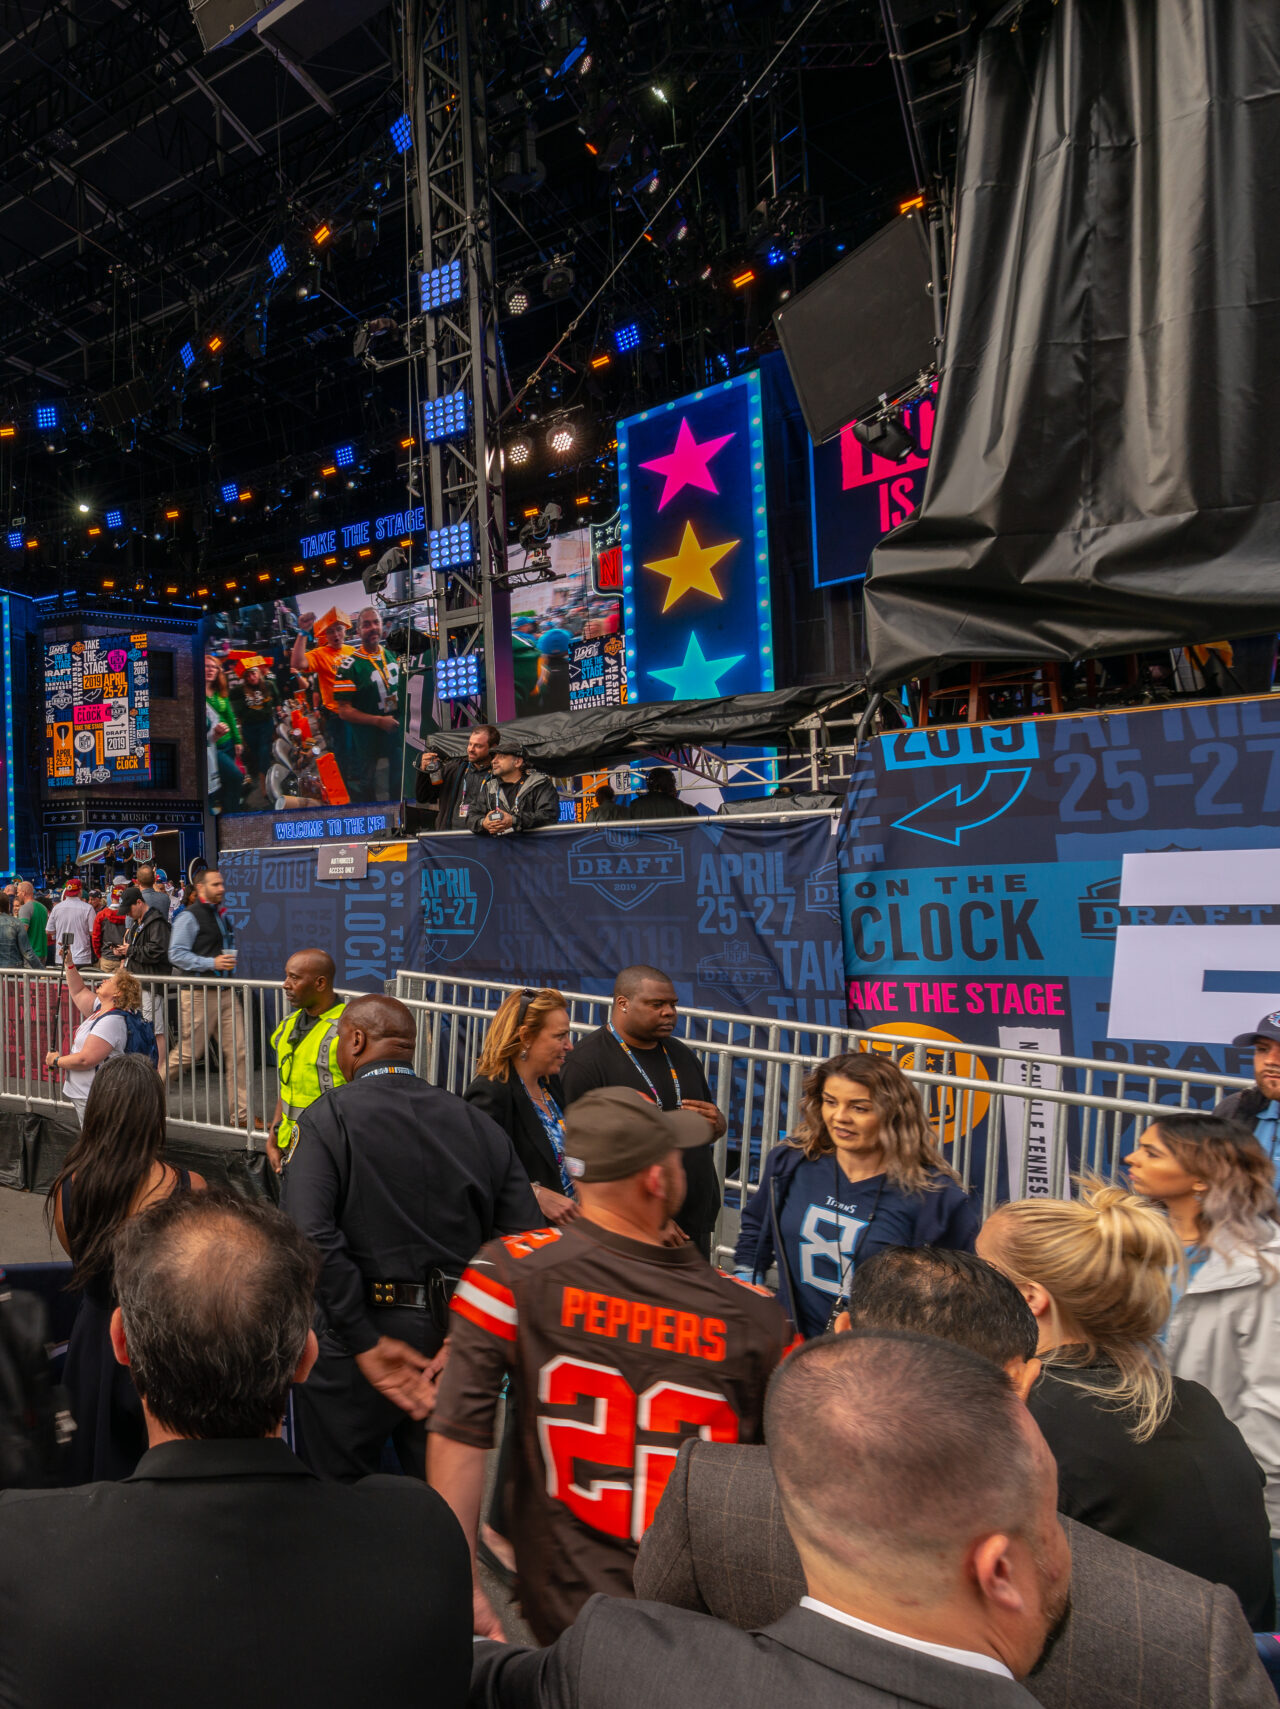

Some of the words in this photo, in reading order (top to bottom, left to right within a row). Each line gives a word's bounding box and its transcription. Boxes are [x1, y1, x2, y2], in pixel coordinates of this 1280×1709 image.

[300, 530, 336, 558] TAKE
[341, 521, 370, 548] THE
[376, 507, 425, 540] STAGE
[84, 639, 100, 650] TAKE
[83, 650, 97, 662] THE
[581, 658, 593, 668] TAKE
[594, 655, 604, 665] THE
[55, 660, 71, 670] STAGE
[83, 660, 109, 675] STAGE
[581, 664, 604, 680] STAGE
[85, 676, 101, 688] 2019
[104, 672, 128, 685] APRIL
[569, 676, 604, 691] RAFT
[103, 685, 128, 698] 25-27
[77, 710, 101, 722] CLOCK
[108, 737, 125, 750] 2019
[56, 749, 71, 757] APRIL
[56, 757, 72, 765] 25-27
[116, 759, 138, 770] CLOCK
[76, 767, 91, 775] APRIL
[75, 775, 92, 784] 25-27
[121, 813, 151, 822] MUSIC
[164, 813, 186, 822] CITY
[275, 820, 324, 840] WELCOME
[327, 819, 342, 836] TO
[344, 817, 365, 835] THE
[135, 849, 150, 859] NFL
[577, 857, 673, 875] DRAFT
[697, 851, 796, 895] APRIL
[225, 868, 259, 886] 25-27
[265, 860, 307, 890] 2019
[390, 871, 405, 908] ON
[421, 868, 478, 898] APRIL
[613, 883, 637, 891] 2019
[854, 879, 909, 899] ON
[934, 874, 1027, 895] THE
[421, 898, 478, 925] 25-27
[697, 896, 796, 935] 25-27
[1092, 904, 1273, 929] DRAFT
[344, 869, 387, 981] CLOCK
[851, 899, 1045, 962] CLOCK
[703, 970, 773, 983] DRAFT
[846, 981, 898, 1012] AKE
[904, 982, 960, 1013] THE
[965, 983, 1065, 1016] STAGE
[561, 1286, 728, 1362] PEPPERS
